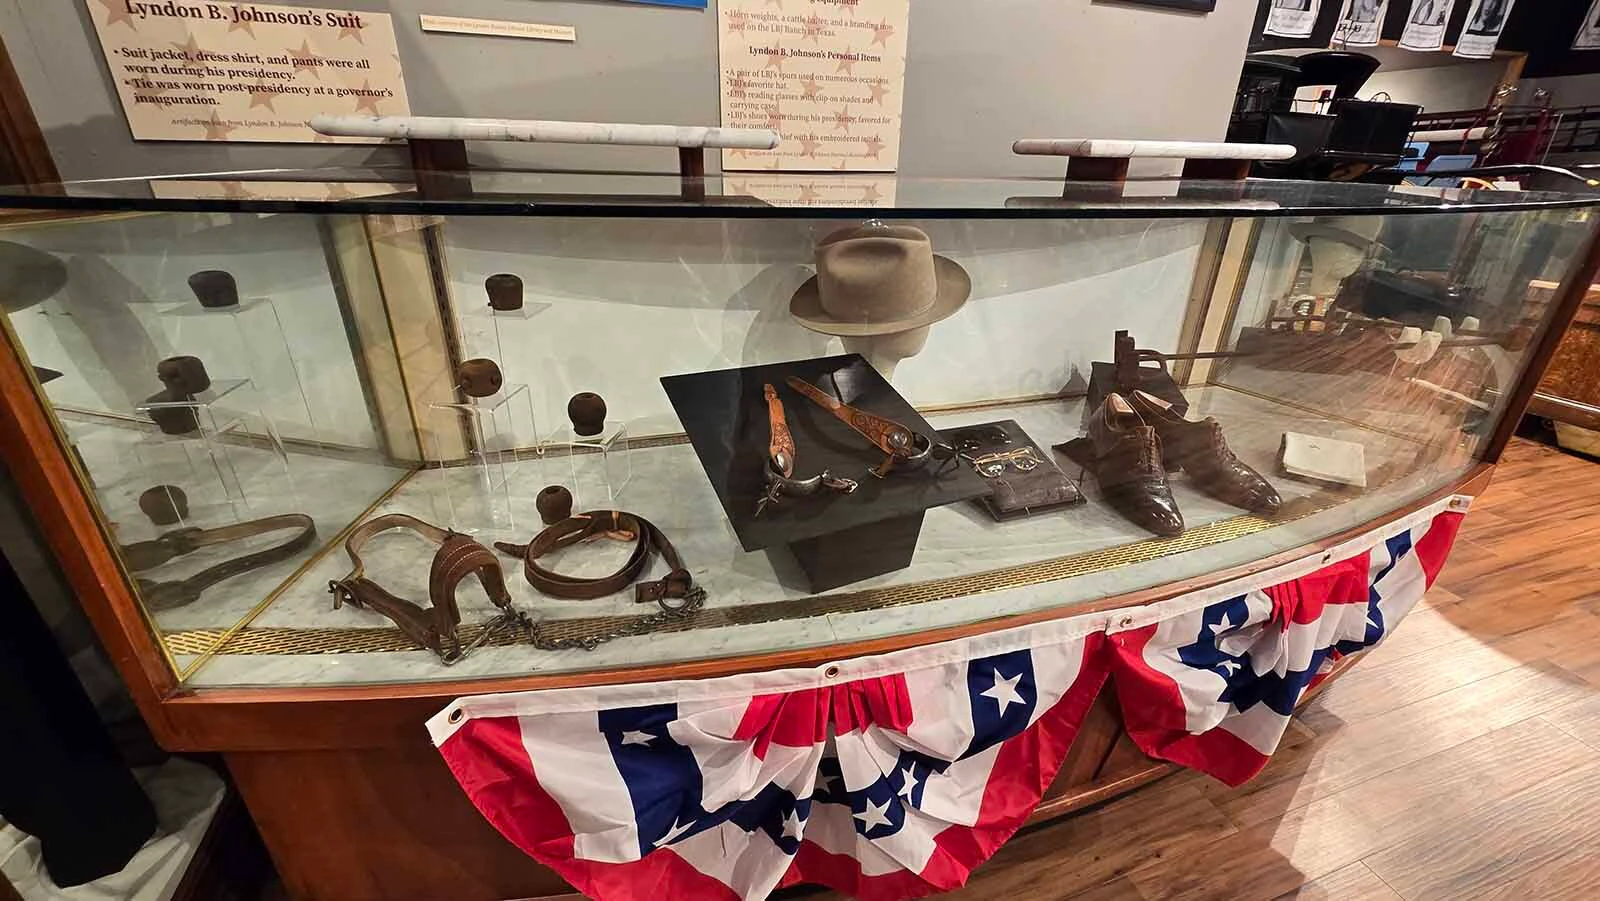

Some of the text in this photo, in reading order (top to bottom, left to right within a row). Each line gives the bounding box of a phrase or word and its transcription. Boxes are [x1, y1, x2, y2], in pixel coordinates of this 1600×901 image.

[125, 0, 203, 19] Lyndon
[206, 4, 227, 20] B.
[326, 12, 363, 28] Suit
[730, 9, 749, 18] Horn
[787, 14, 805, 23] cattle
[830, 17, 842, 26] and
[850, 20, 878, 31] branding
[728, 22, 745, 30] used
[758, 23, 769, 32] the
[771, 24, 782, 33] LBJ
[785, 25, 806, 34] Ranch
[807, 27, 814, 35] in
[121, 47, 370, 69] Suit jacket, dress shirt, and pants were all
[749, 46, 779, 56] Lyndon
[780, 48, 789, 56] B.
[827, 51, 859, 61] Personal
[124, 64, 296, 81] worn during his presidency.
[737, 70, 750, 78] pair
[798, 72, 814, 80] used
[132, 79, 154, 88] Tie
[155, 81, 180, 89] was
[182, 82, 215, 91] worn
[217, 83, 311, 96] post-presidency
[314, 86, 326, 94] at
[748, 80, 774, 89] favorite
[134, 93, 220, 105] inauguration.
[748, 91, 774, 101] reading
[800, 93, 814, 101] with
[862, 96, 874, 104] and
[730, 101, 759, 110] carrying
[788, 114, 810, 123] during
[858, 115, 881, 124] favored
[809, 133, 819, 141] his
[820, 135, 860, 143] embroidered
